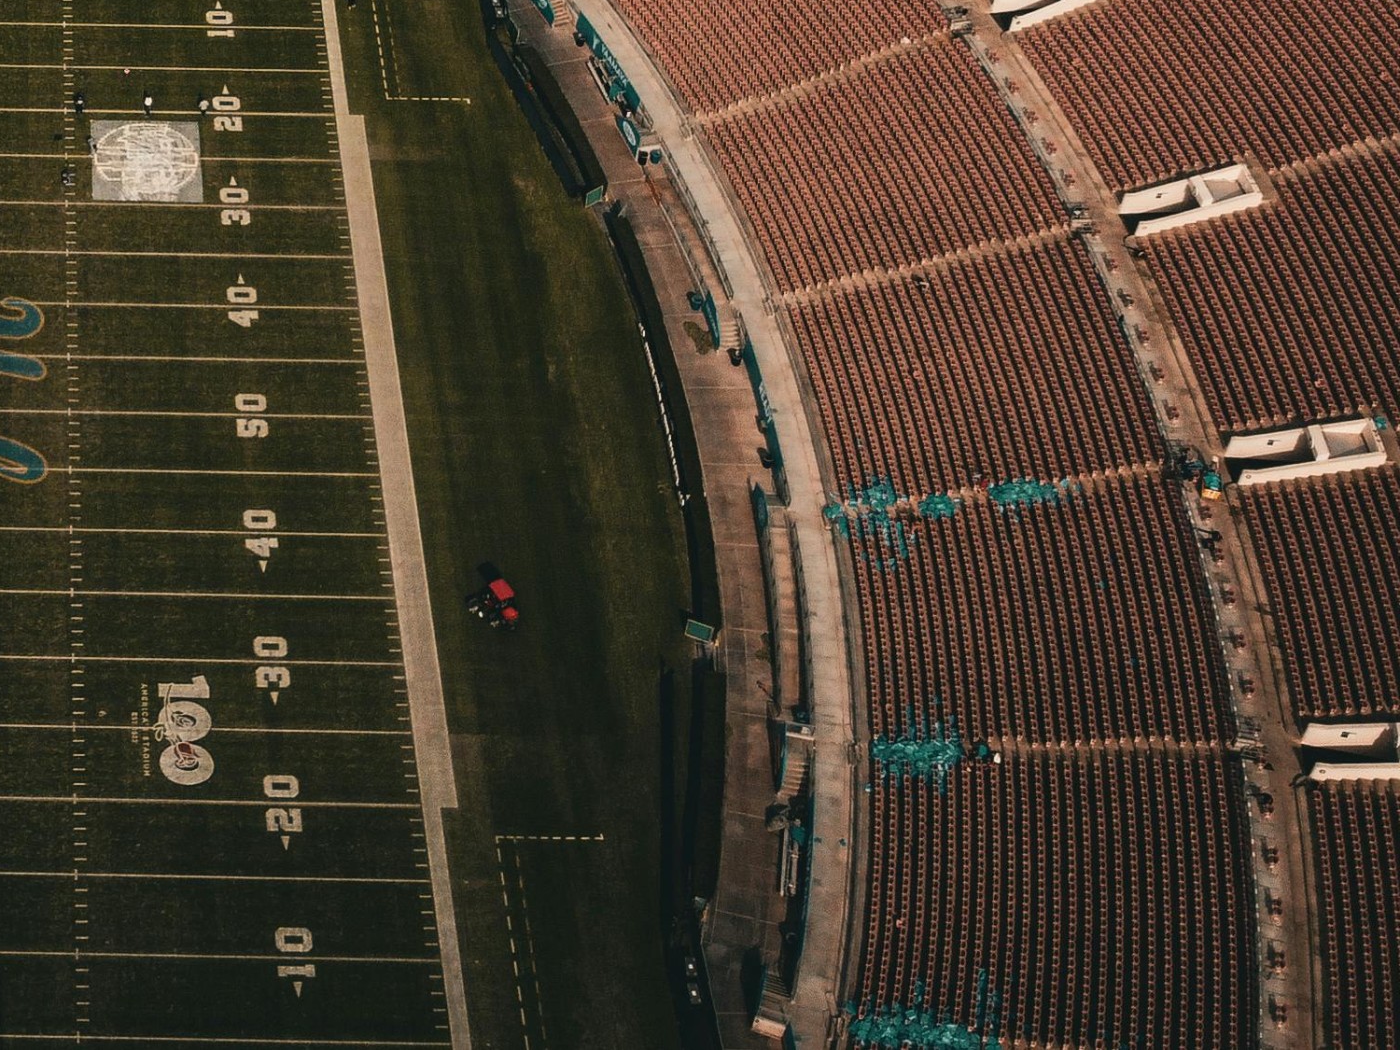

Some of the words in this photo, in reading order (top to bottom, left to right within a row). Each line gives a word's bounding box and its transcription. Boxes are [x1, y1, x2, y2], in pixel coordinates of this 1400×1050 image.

[205, 10, 235, 37] 10
[212, 96, 243, 132] 20
[219, 187, 250, 225] 30
[226, 286, 259, 327] 40
[235, 393, 269, 438] 50
[243, 509, 279, 557] 40
[253, 636, 291, 688] 30
[158, 675, 215, 785] 100
[263, 775, 303, 832] 20
[274, 926, 316, 977] 10
